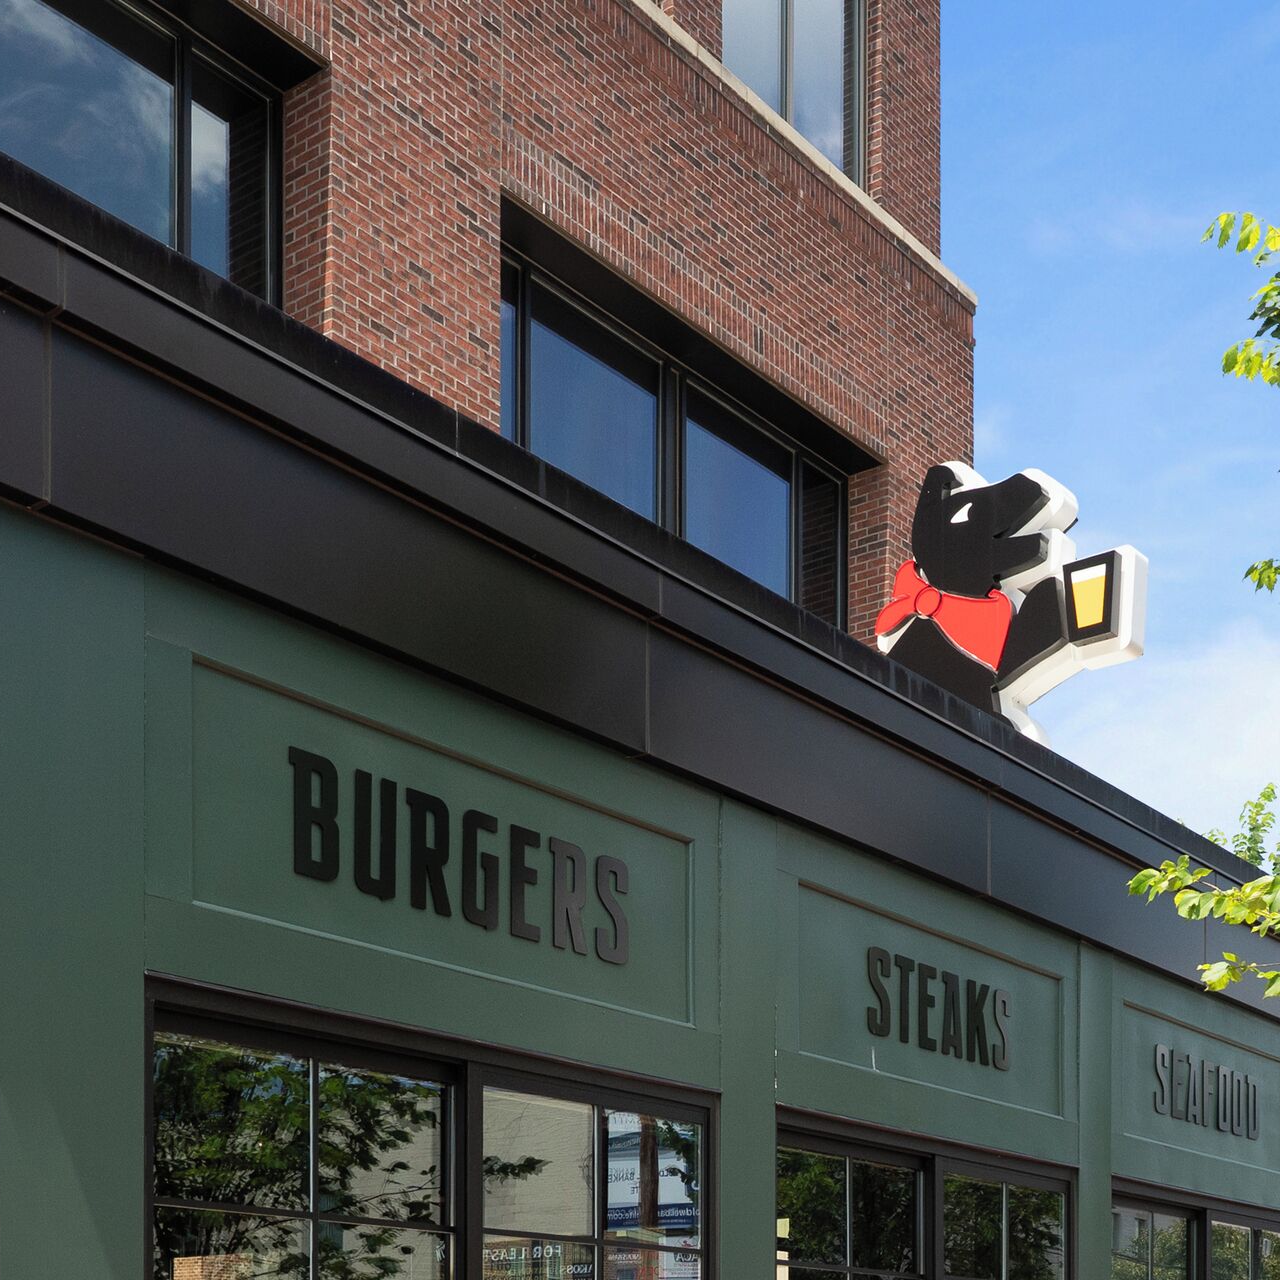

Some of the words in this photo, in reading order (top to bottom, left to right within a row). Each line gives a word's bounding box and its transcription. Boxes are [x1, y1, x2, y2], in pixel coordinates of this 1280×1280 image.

[288, 746, 629, 965] BURGERS
[867, 946, 1011, 1071] STEAKS
[1153, 1043, 1259, 1141] SEAFOOD
